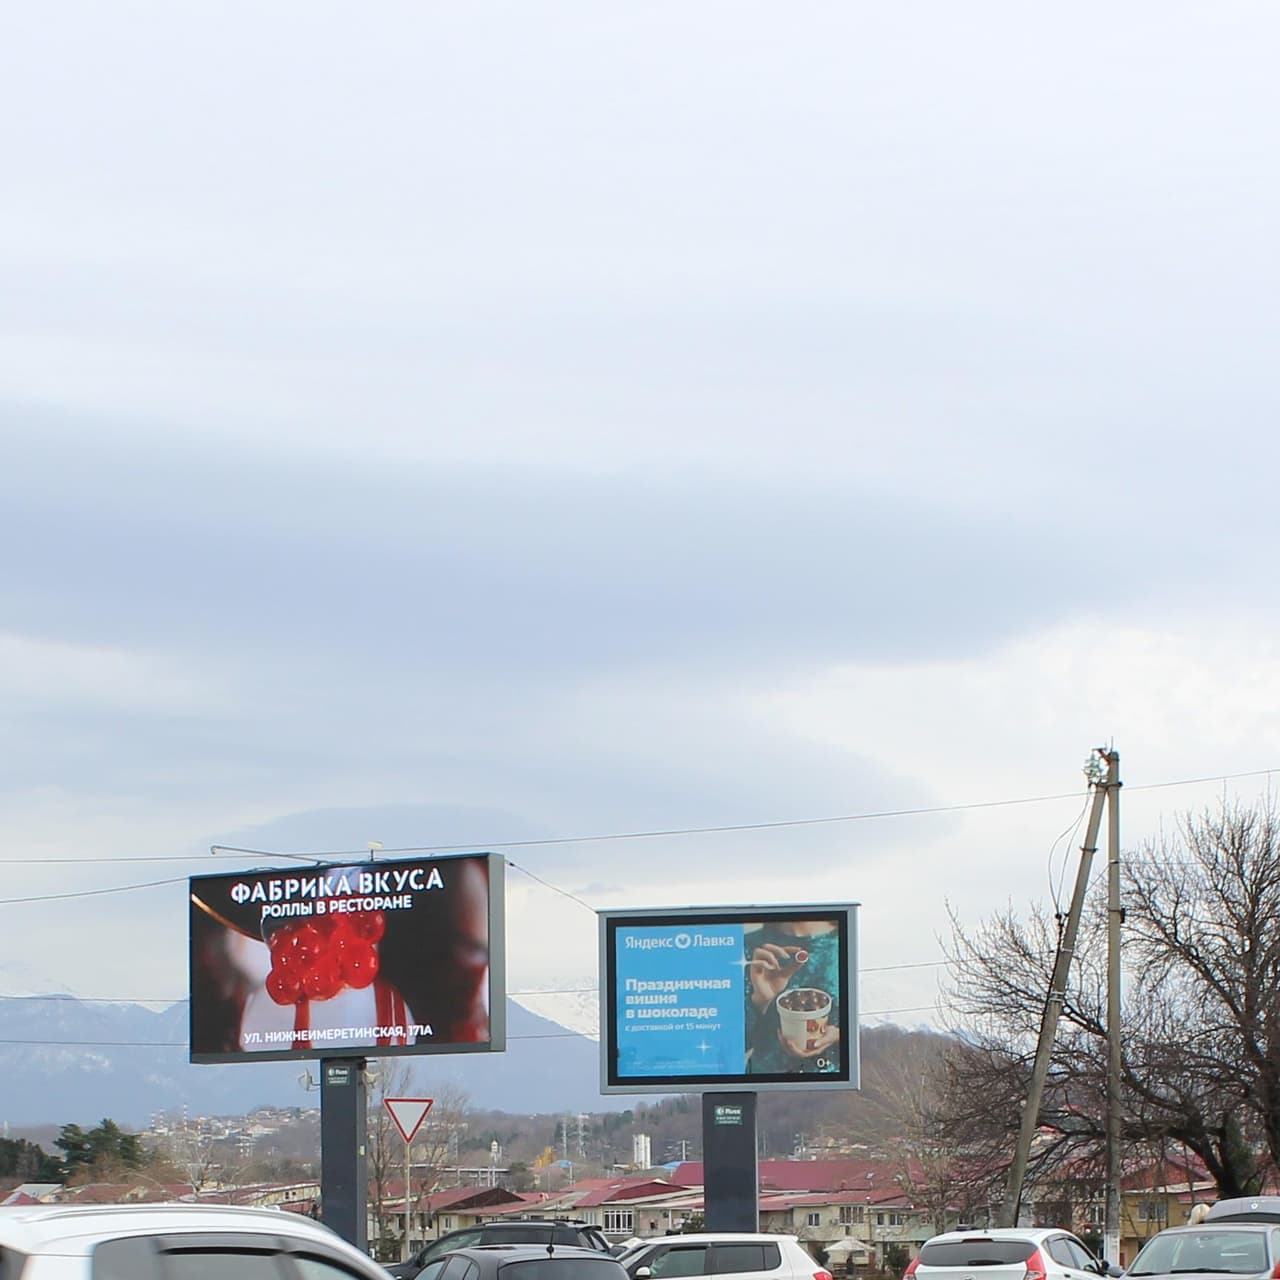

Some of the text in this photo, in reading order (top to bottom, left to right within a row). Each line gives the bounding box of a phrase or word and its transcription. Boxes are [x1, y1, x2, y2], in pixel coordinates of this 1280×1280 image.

[231, 868, 444, 904] ФАБРИКА ВКУСА
[261, 895, 412, 918] РОЛЛЫ В РЕСТОРАНЕ
[625, 934, 735, 949] Яндекс Лавка
[625, 978, 732, 992] Праздничная
[625, 995, 678, 1005] вишня
[625, 1007, 718, 1019] в шоколаде
[243, 1024, 433, 1044] УЛ. НИЖНЕИМЕРЕТИНСКАЯ, 171А
[816, 1058, 831, 1068] 0+
